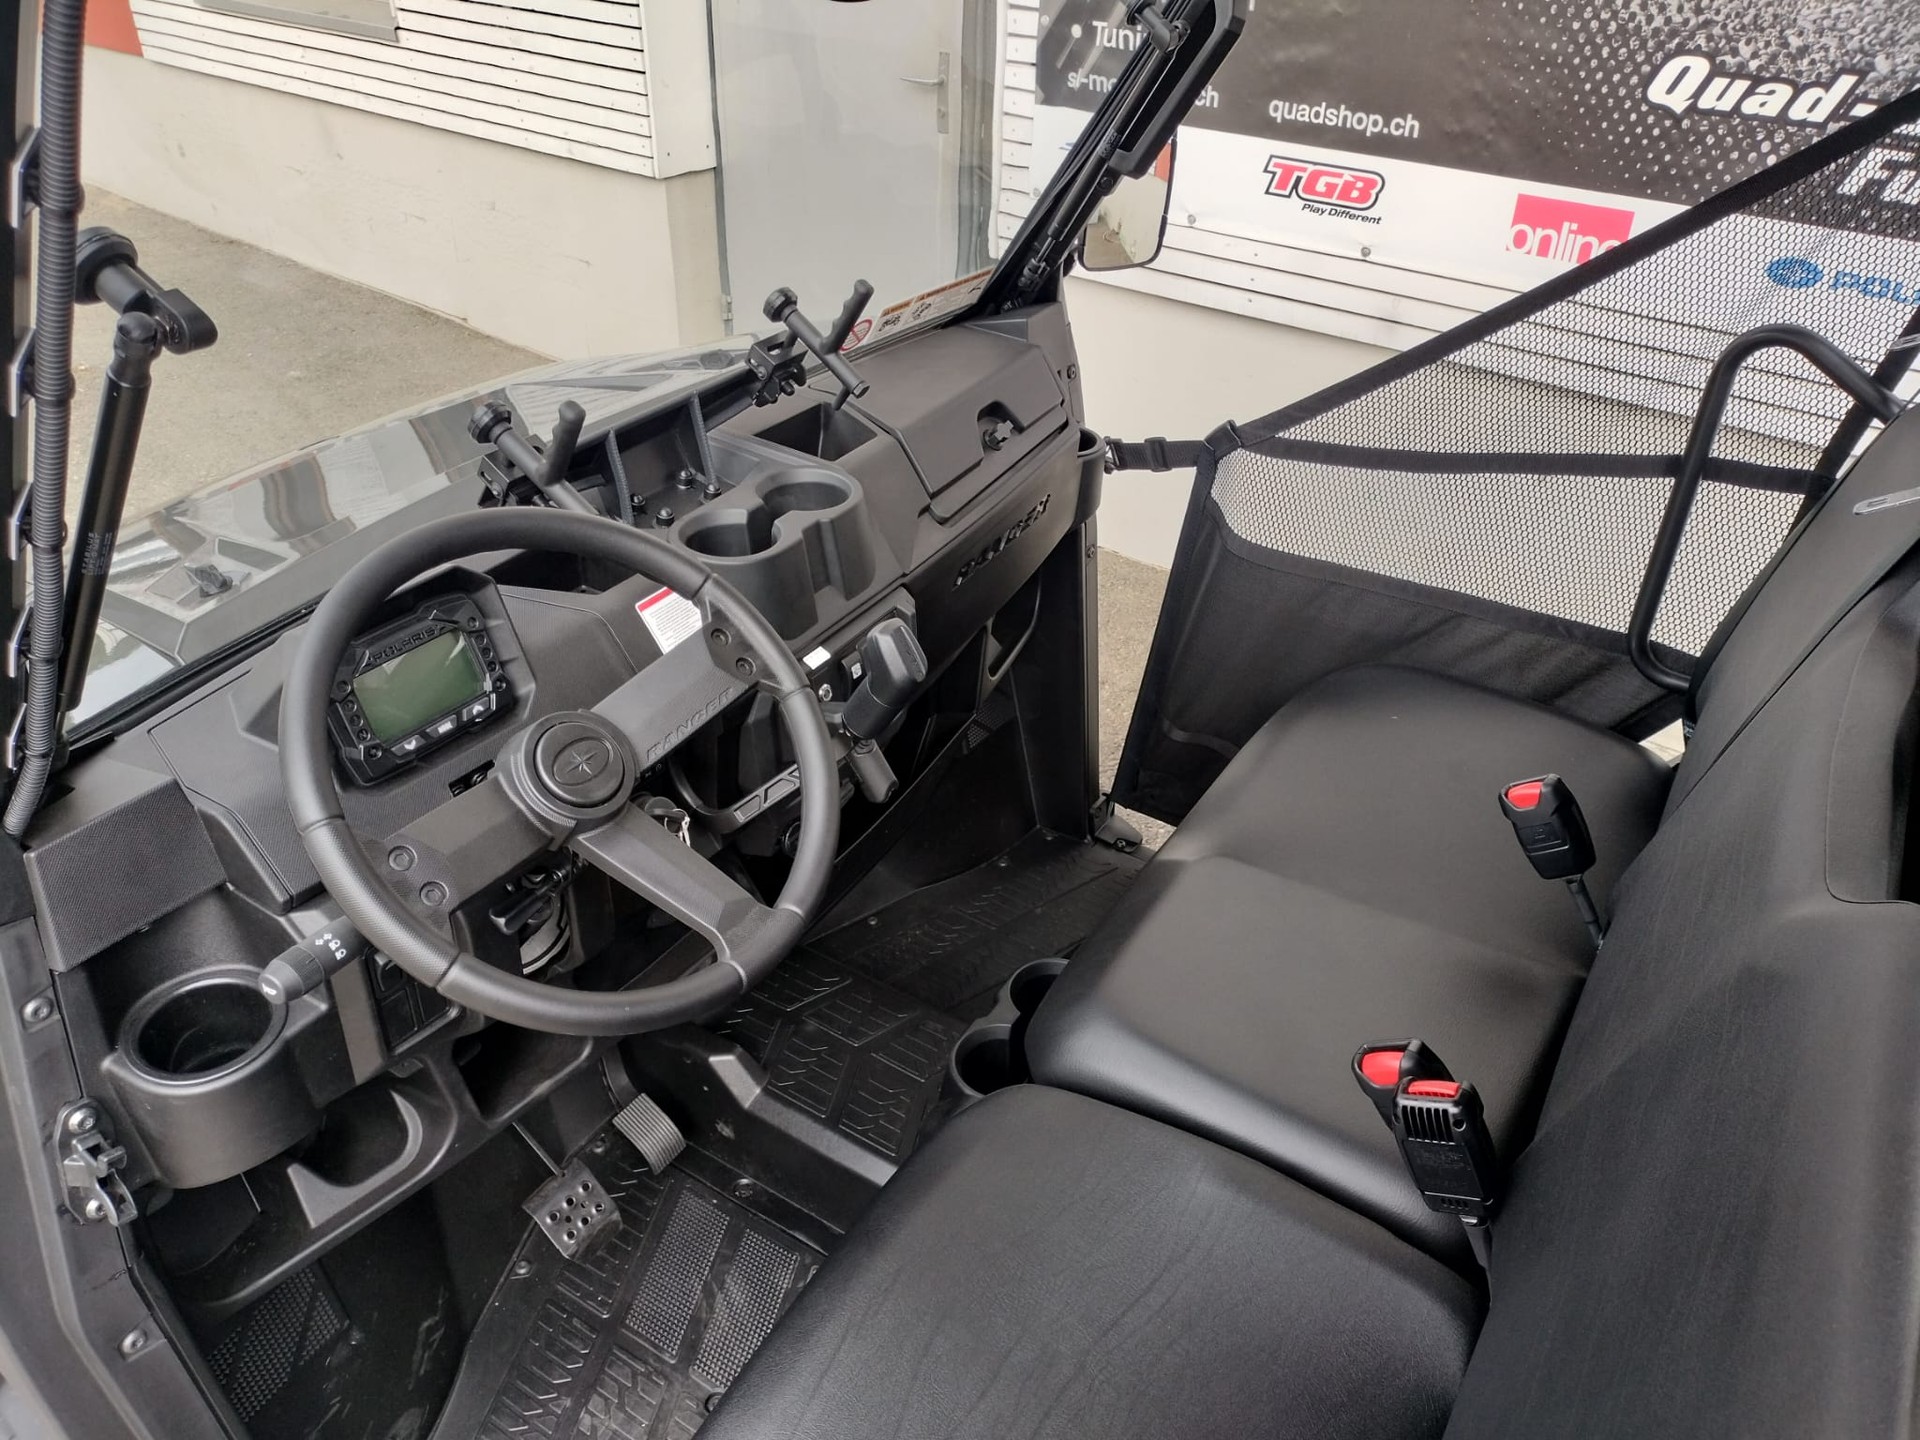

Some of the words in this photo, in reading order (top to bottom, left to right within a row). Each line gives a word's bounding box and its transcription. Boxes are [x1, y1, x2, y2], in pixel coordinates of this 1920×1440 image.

[1268, 99, 1420, 138] quadshop.ch
[1268, 158, 1382, 206] TGB
[1301, 203, 1328, 217] Play
[1328, 208, 1382, 225] Different
